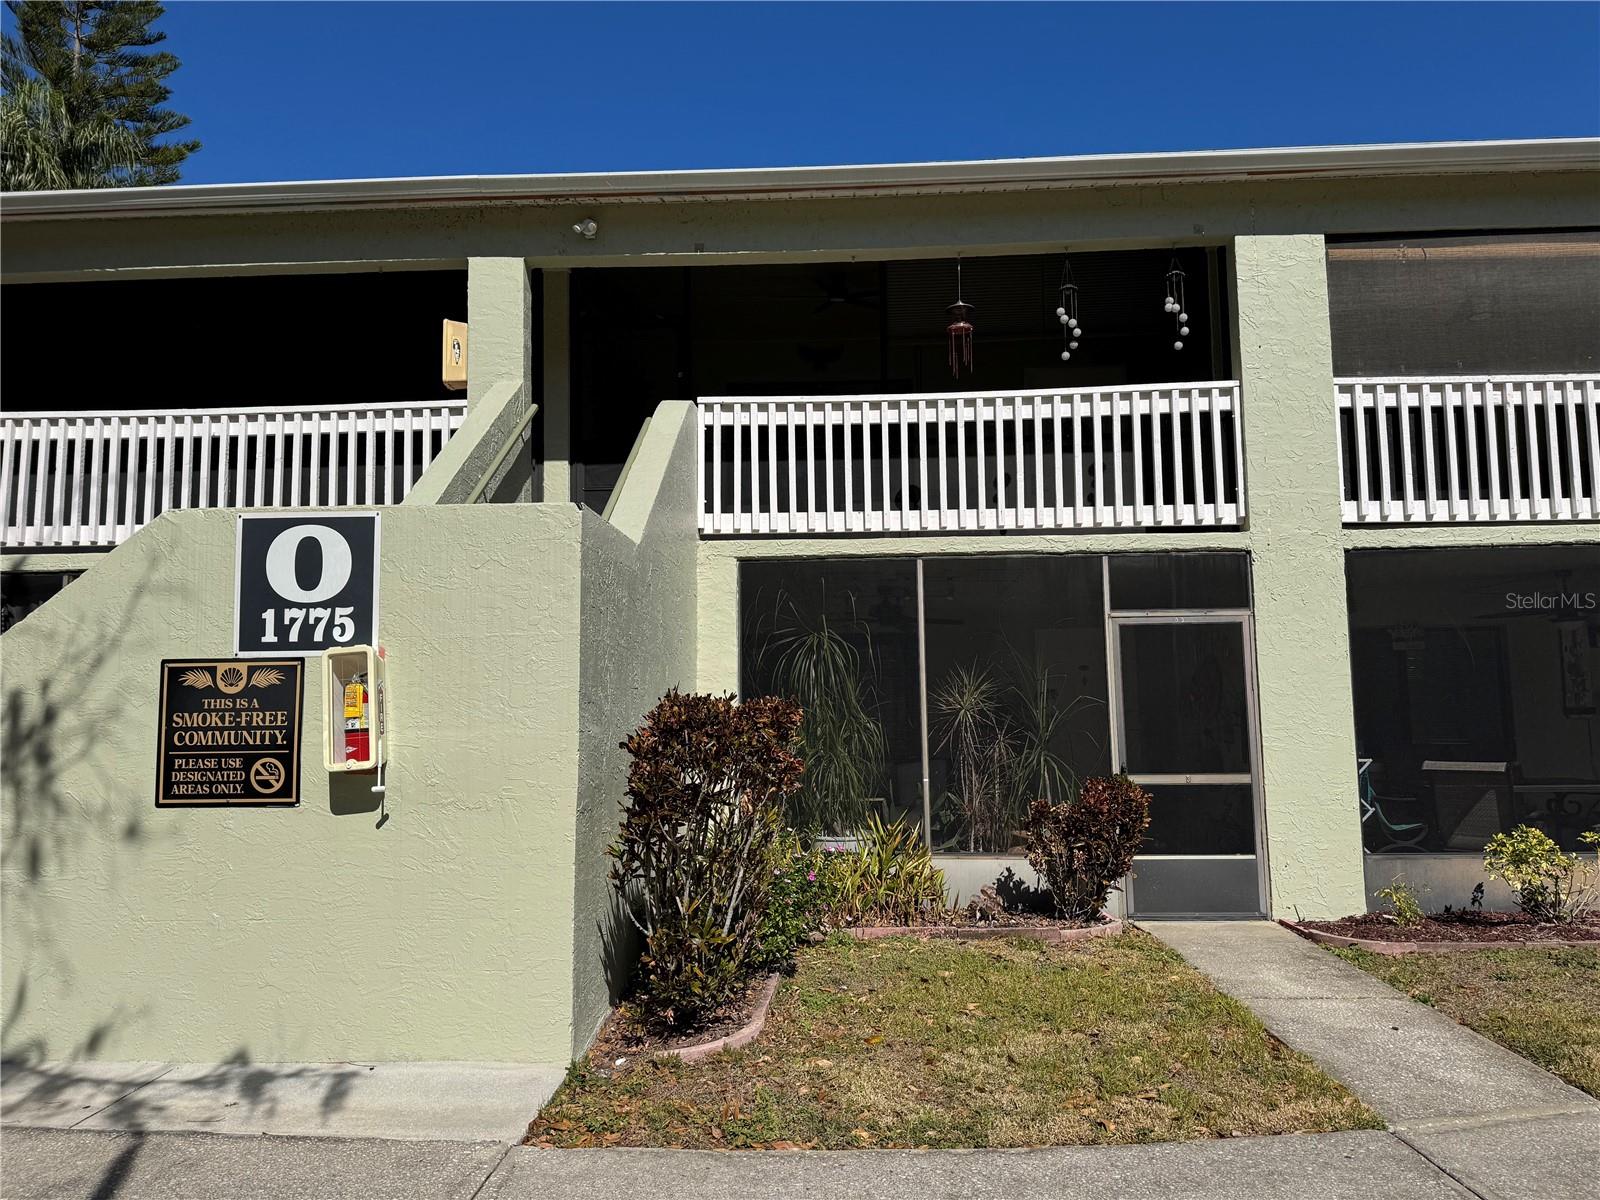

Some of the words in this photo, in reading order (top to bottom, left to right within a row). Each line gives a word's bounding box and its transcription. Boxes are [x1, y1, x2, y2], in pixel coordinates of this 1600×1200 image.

[265, 524, 353, 604] O
[260, 606, 356, 643] 1775
[202, 698, 233, 709] THIS
[235, 698, 249, 709] IS
[250, 698, 260, 709] A
[172, 711, 288, 728] SMOKE-FREE
[173, 729, 288, 746] COMMUNITY.
[174, 758, 219, 769] PLEASE
[221, 758, 244, 769] USE
[171, 770, 246, 782] DESIGNATED
[171, 783, 210, 795] AREAS
[212, 783, 245, 795] ONLY.
